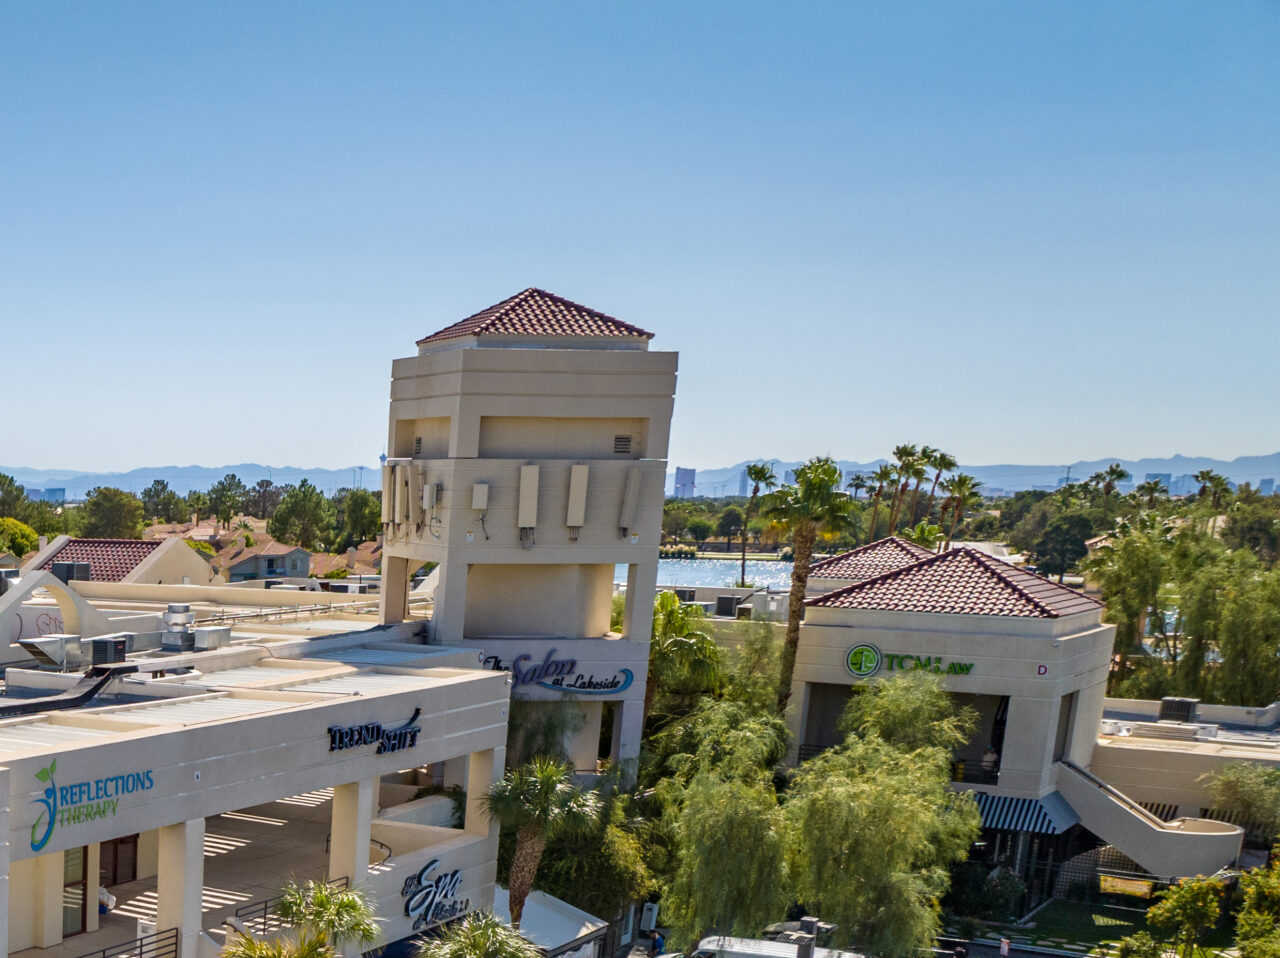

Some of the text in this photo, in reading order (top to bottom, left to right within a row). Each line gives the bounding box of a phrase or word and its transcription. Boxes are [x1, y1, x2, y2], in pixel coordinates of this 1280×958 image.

[512, 648, 577, 689] Salon
[552, 674, 620, 690] at Lakeside
[1037, 664, 1049, 676] D
[327, 722, 383, 752] TREND
[60, 769, 154, 807] REFLECTIONS
[58, 798, 120, 827] THERAPY
[405, 859, 463, 924] Spa
